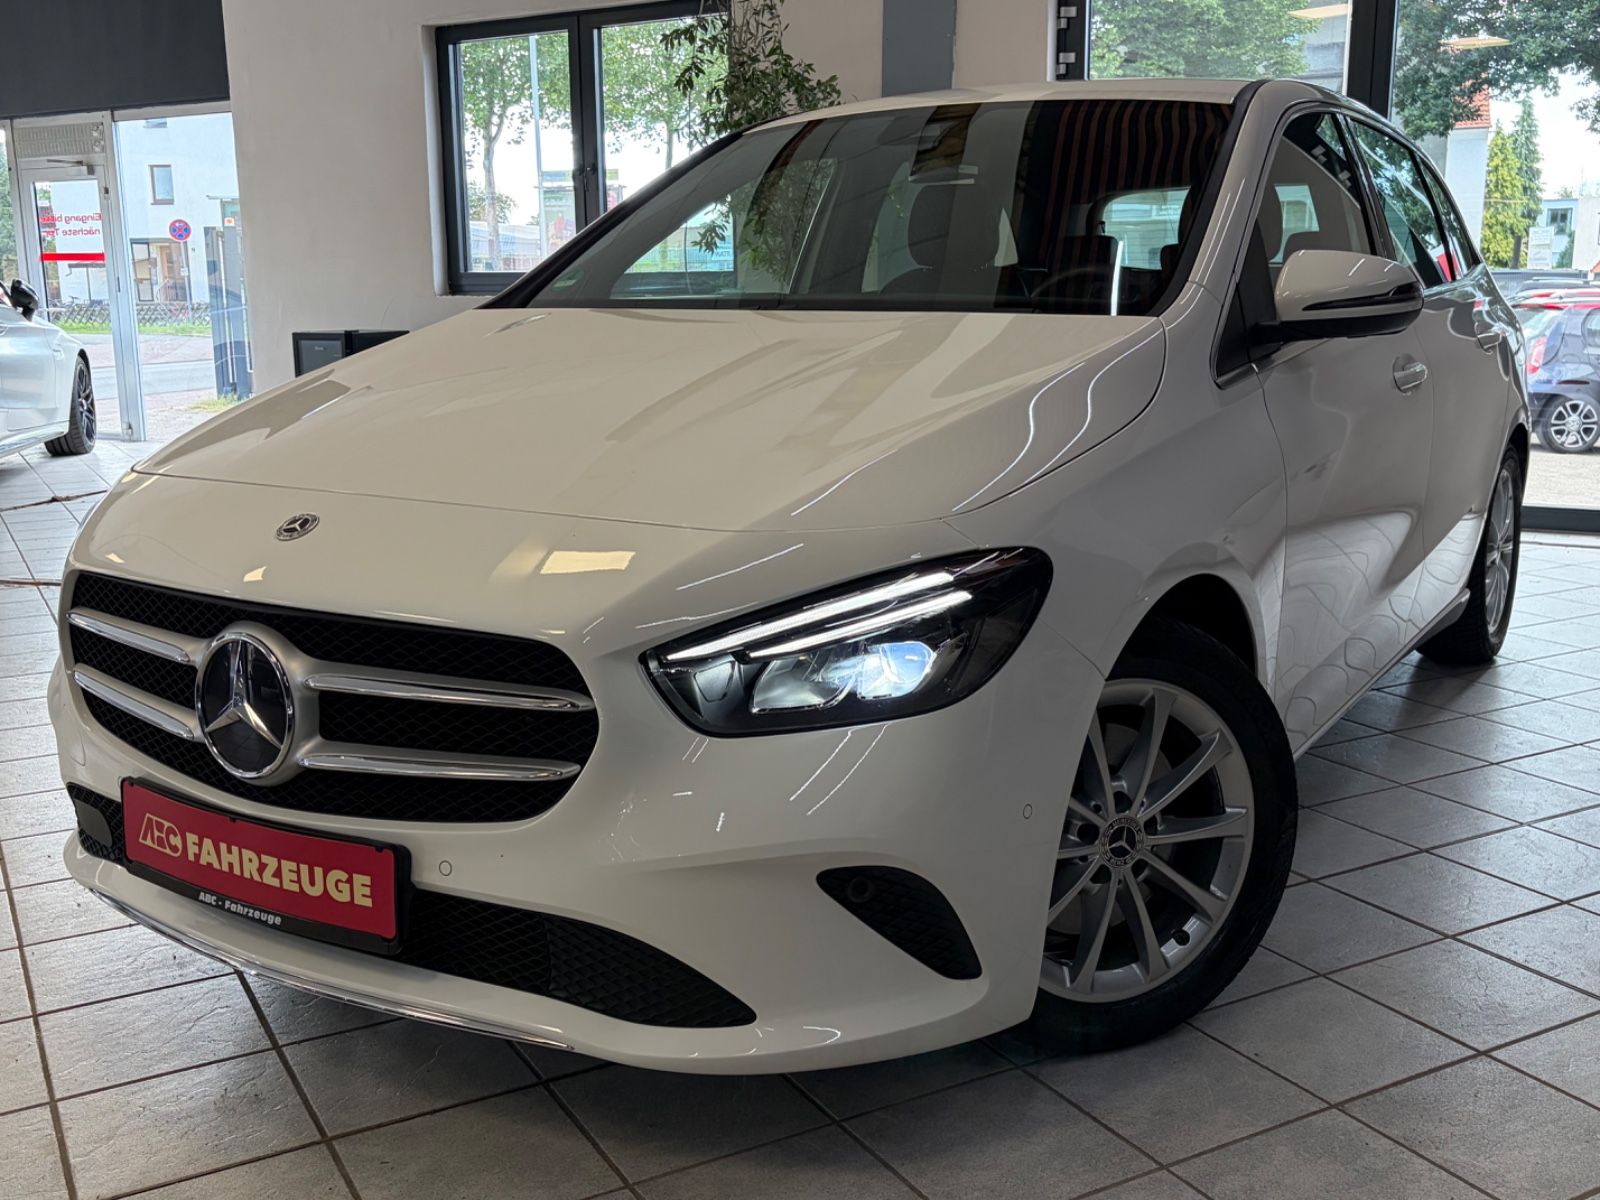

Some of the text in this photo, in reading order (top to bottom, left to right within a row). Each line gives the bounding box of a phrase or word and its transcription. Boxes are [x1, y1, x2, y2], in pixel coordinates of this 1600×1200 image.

[185, 831, 373, 908] FAHRZEUGE
[198, 891, 217, 906] ABC
[224, 899, 282, 925] Fahrzeuge
